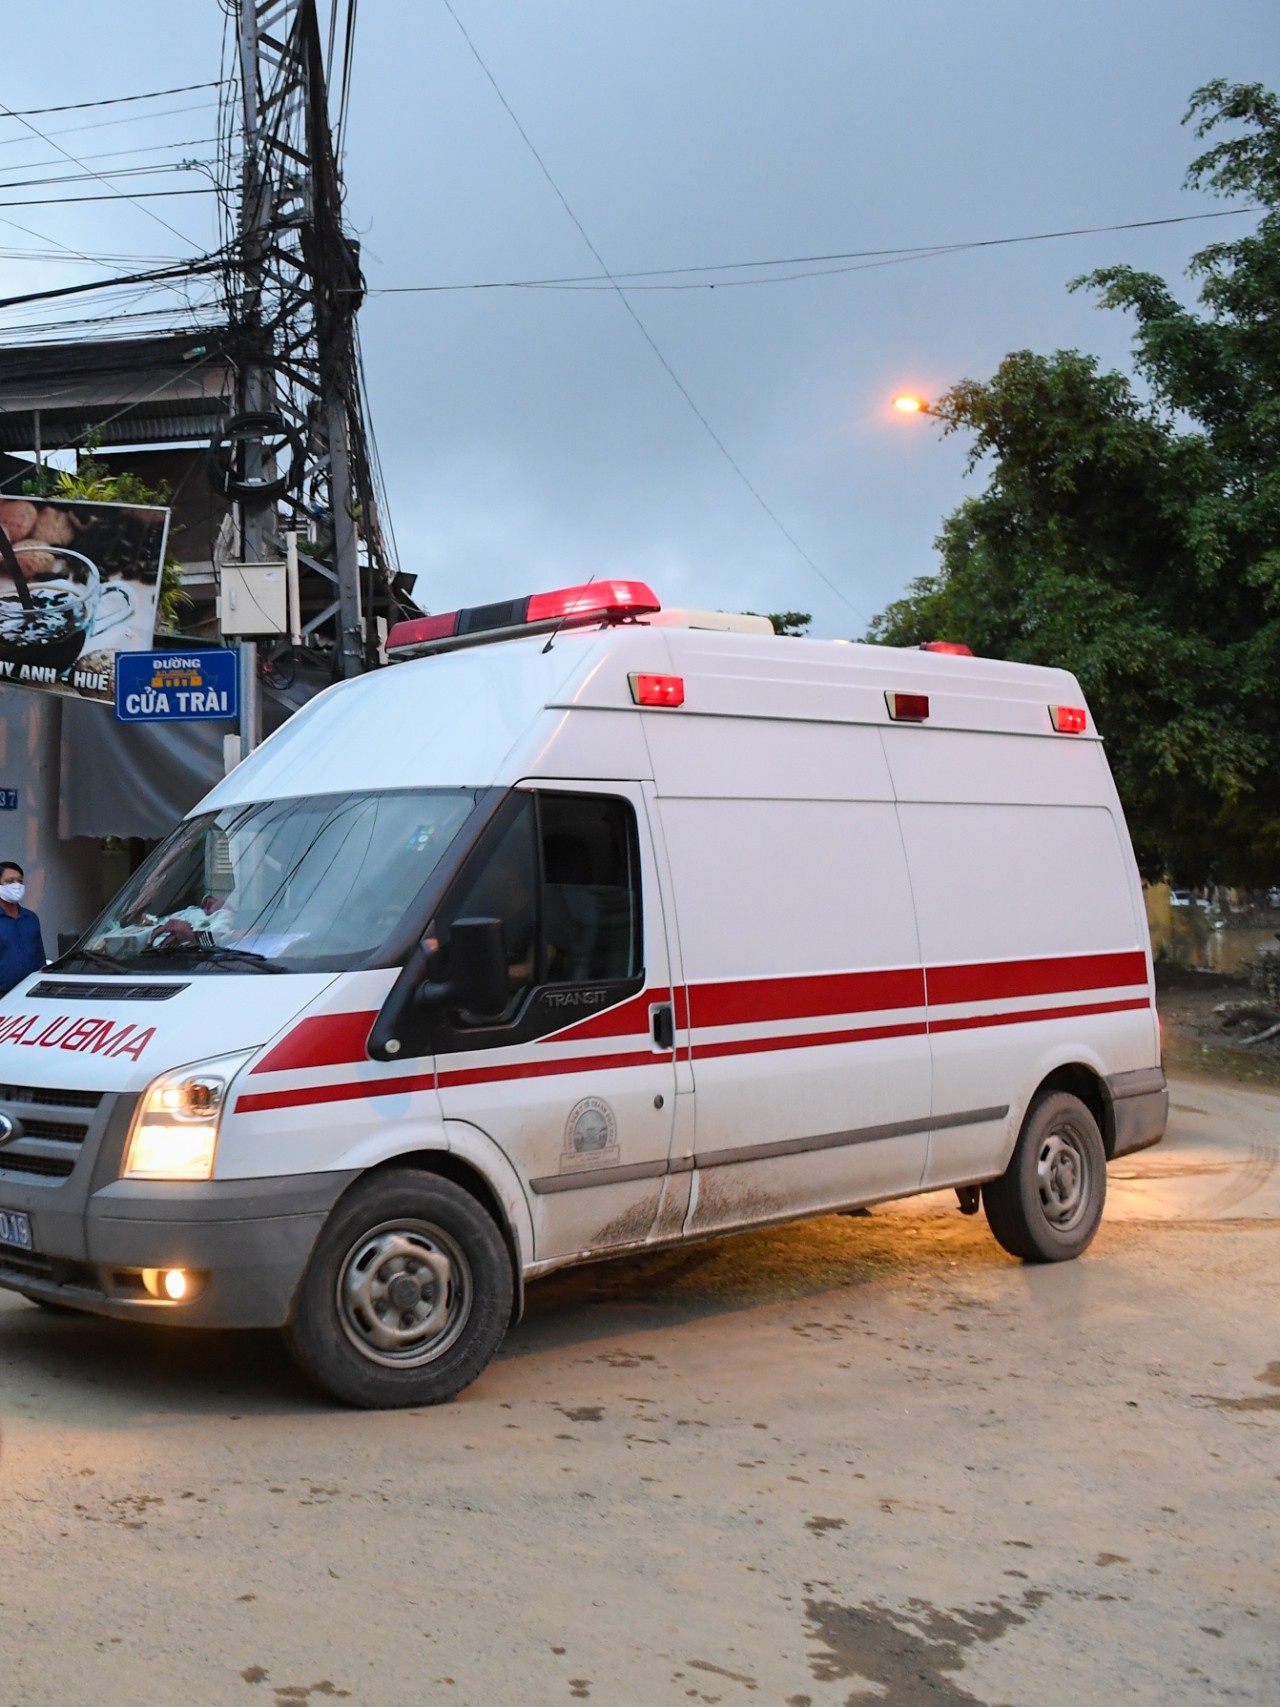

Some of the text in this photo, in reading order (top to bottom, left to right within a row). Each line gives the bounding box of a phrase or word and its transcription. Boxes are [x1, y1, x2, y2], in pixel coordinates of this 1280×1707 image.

[152, 656, 201, 670] ĐƯỜNG
[20, 664, 57, 684] ANH
[126, 686, 228, 714] CỬA TRÀI
[545, 990, 607, 1007] TRANSIT
